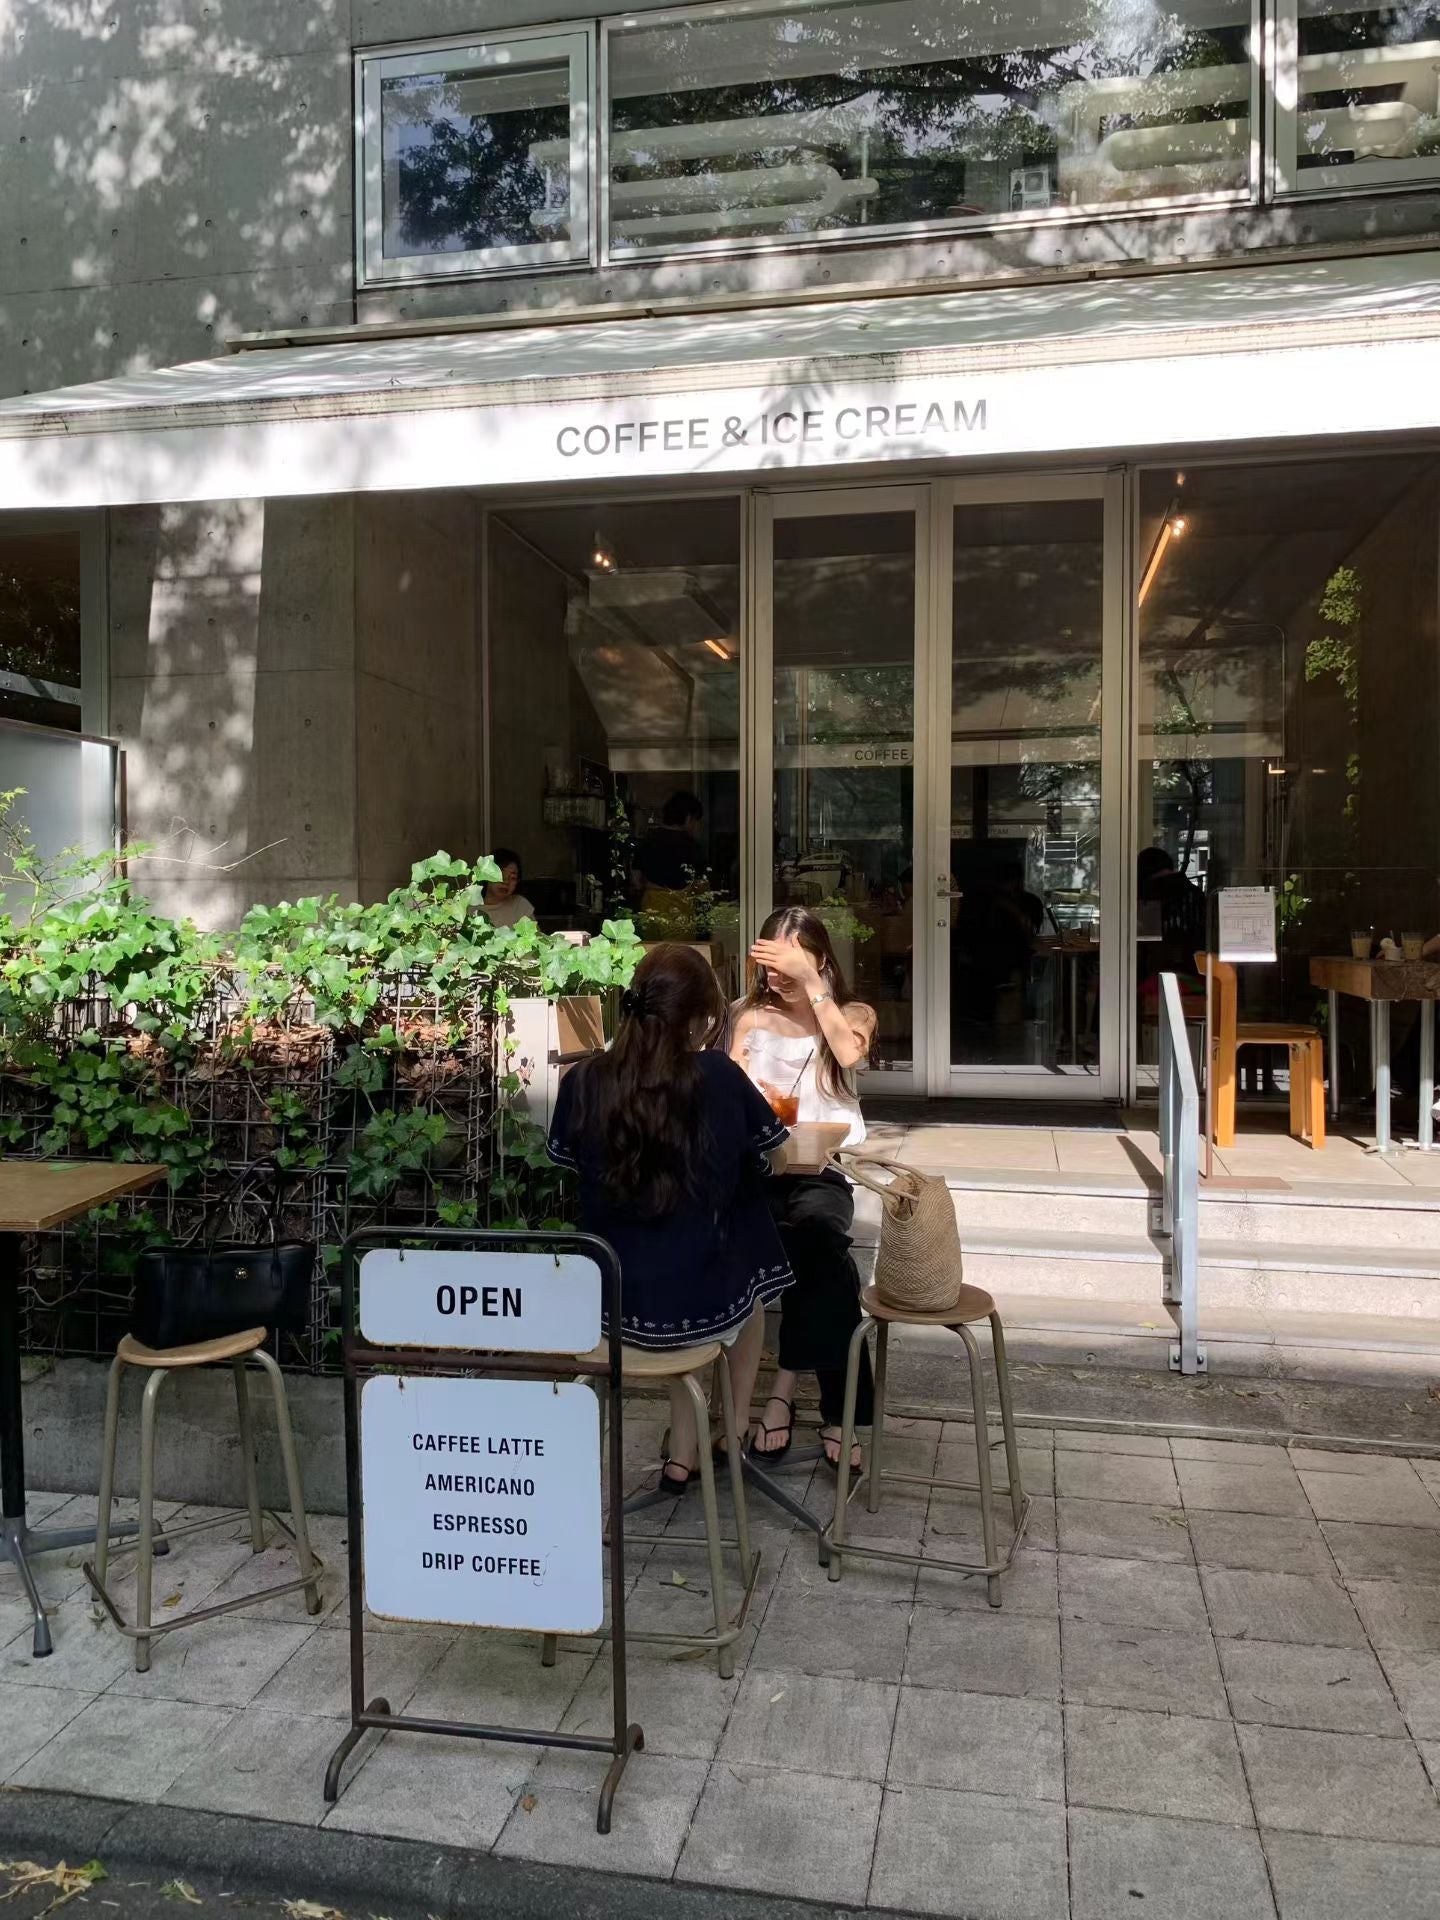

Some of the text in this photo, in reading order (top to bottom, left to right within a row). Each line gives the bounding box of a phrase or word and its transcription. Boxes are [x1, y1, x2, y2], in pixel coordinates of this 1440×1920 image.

[557, 399, 987, 457] COFFEE & ICE CREAM
[855, 749, 909, 760] COFFEE
[437, 1285, 521, 1317] OPEN
[413, 1433, 544, 1456] CAFFEE LATTE
[425, 1474, 535, 1496] AMERICANO
[433, 1514, 528, 1535] ESPRESSO
[422, 1552, 540, 1576] DRIP COFFEE
